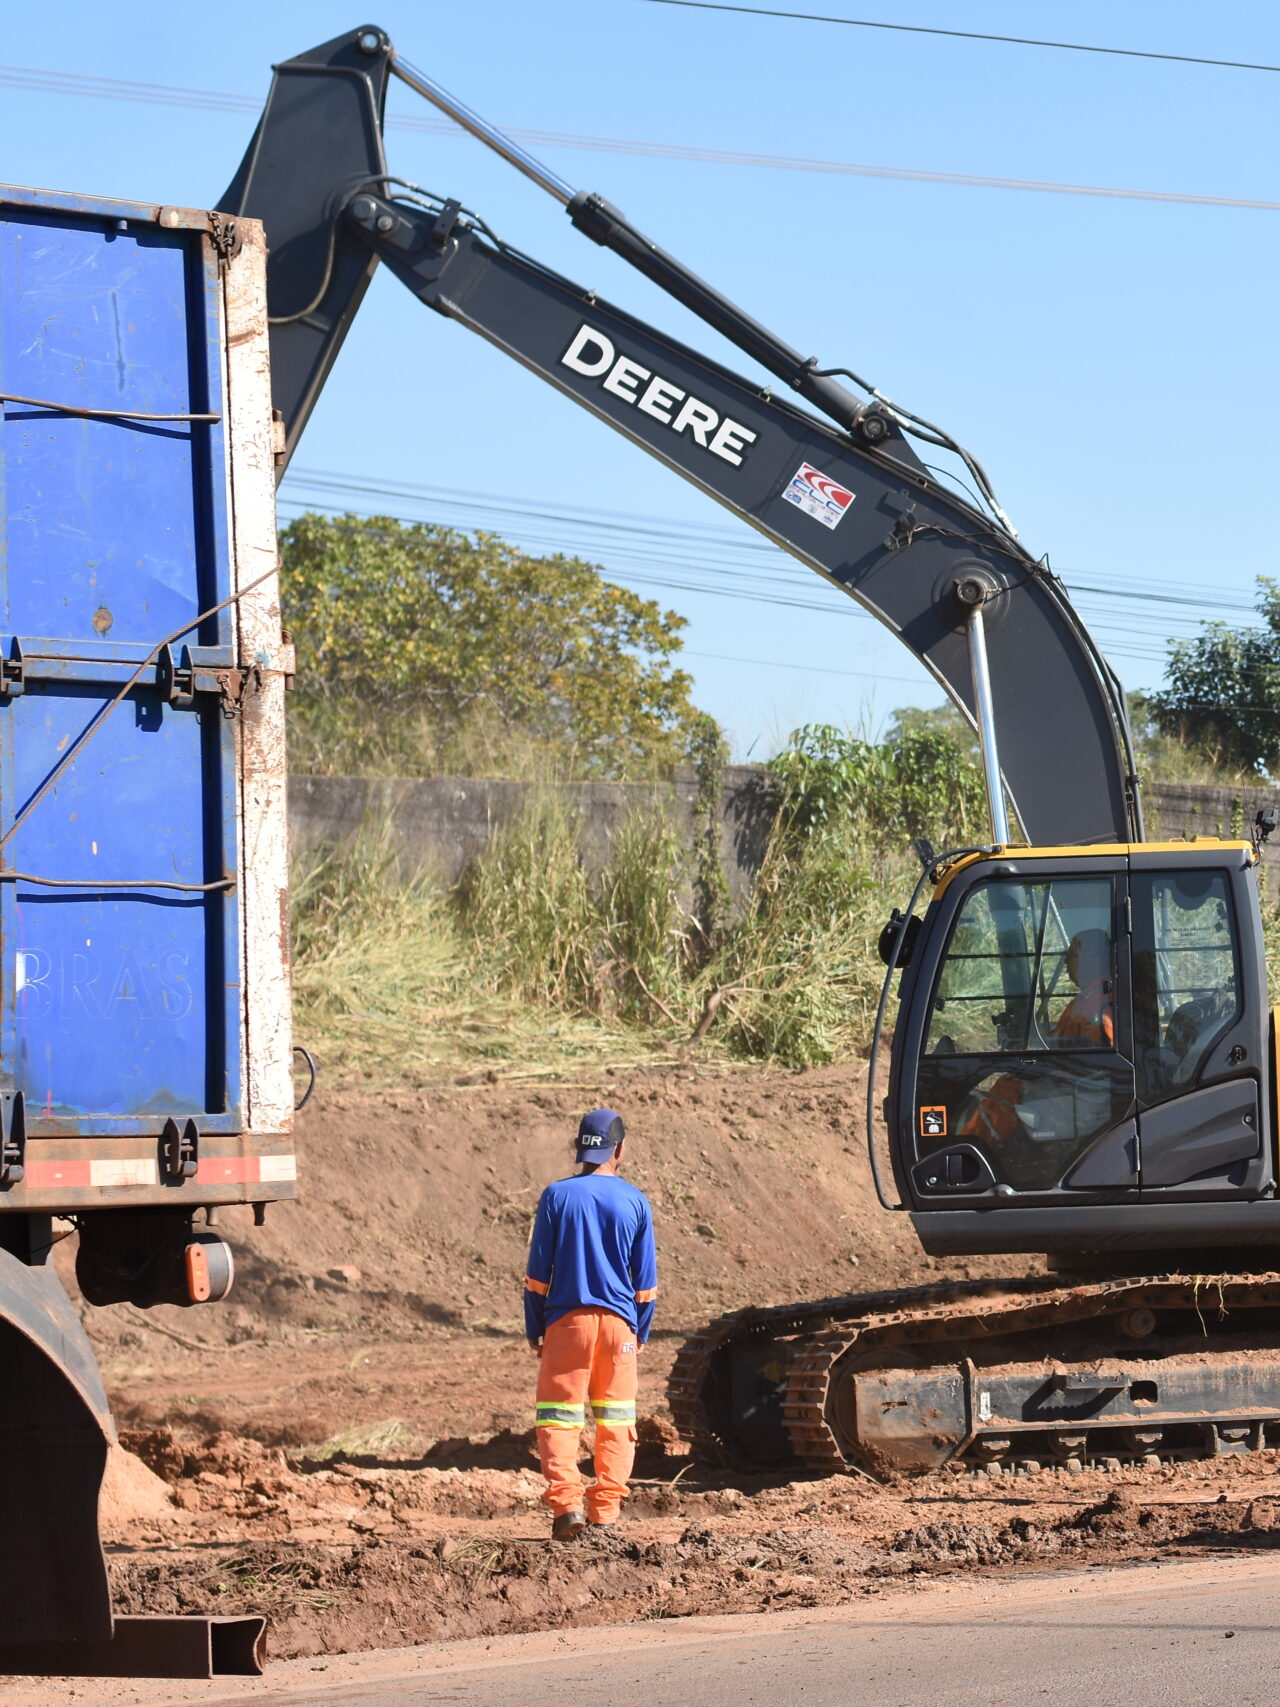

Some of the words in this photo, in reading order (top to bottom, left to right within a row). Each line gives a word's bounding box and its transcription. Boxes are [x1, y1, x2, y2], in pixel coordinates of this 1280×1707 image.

[561, 323, 757, 467] DEERE
[792, 478, 844, 516] CLC
[581, 1134, 603, 1146] DR
